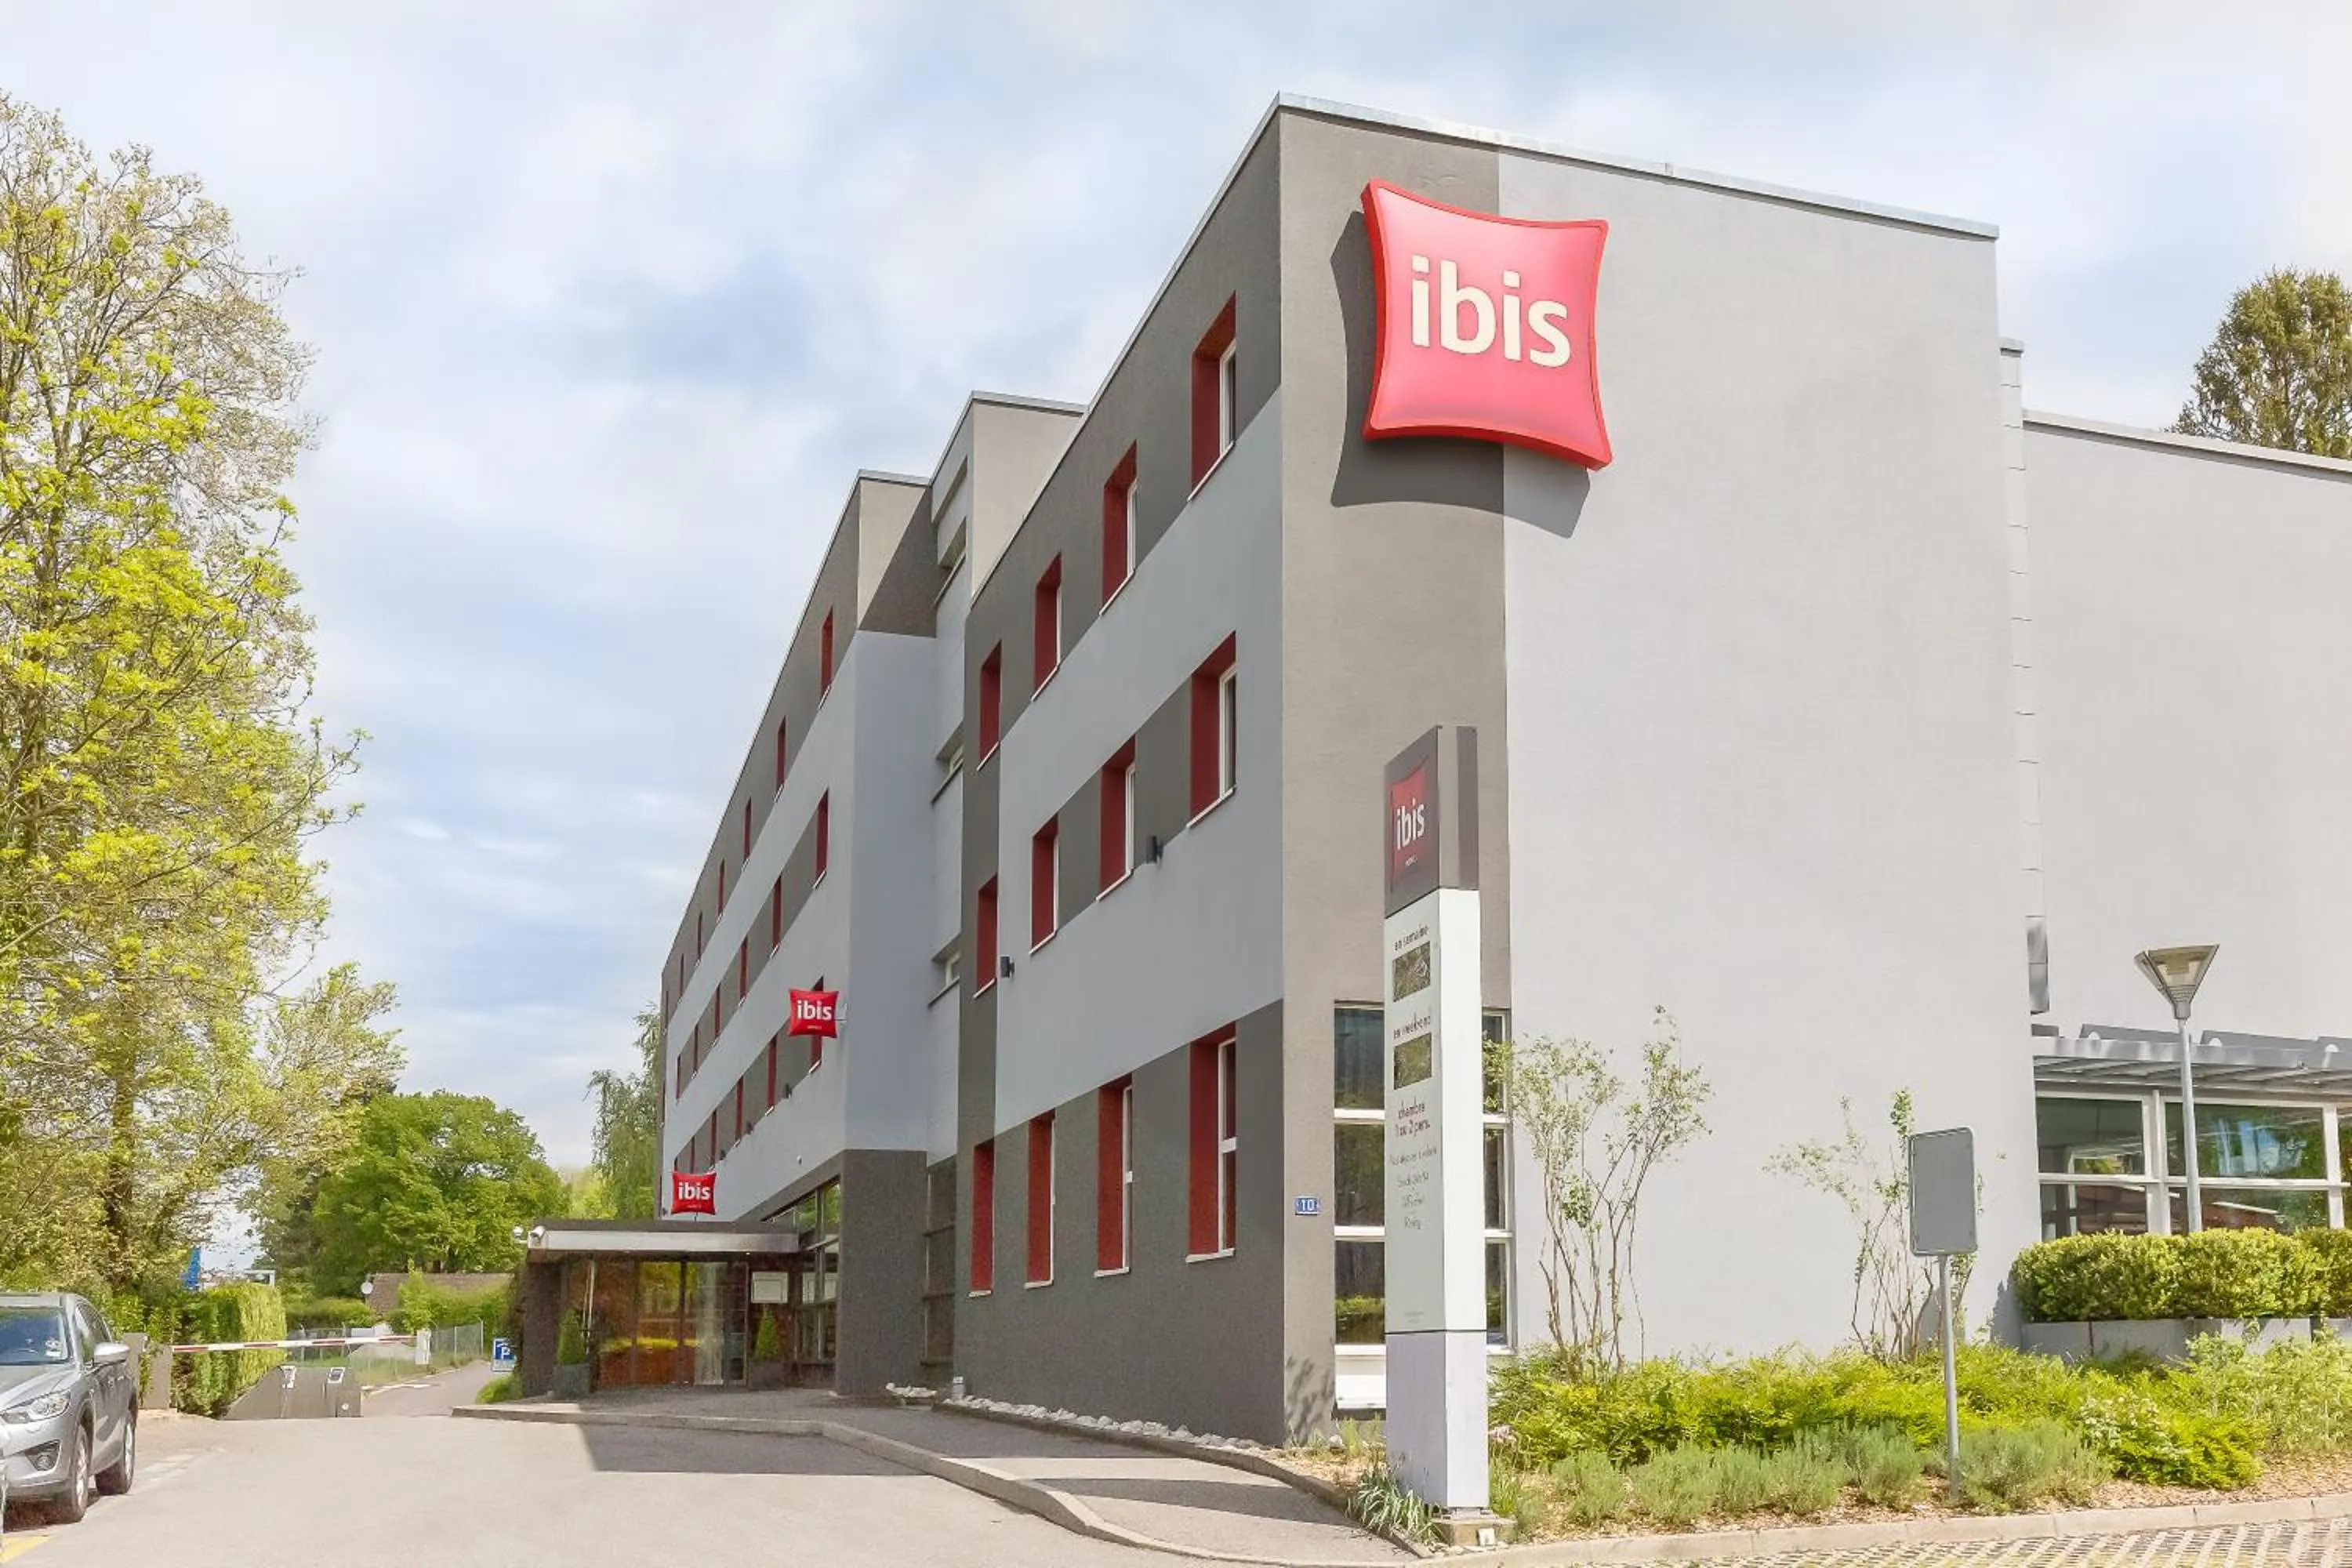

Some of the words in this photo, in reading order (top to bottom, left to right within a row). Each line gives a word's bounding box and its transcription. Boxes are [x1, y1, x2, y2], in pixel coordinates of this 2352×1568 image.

[1411, 254, 1570, 368] ibis
[1397, 797, 1425, 851] ibis
[797, 1000, 832, 1020] ibis
[678, 1181, 710, 1200] ibis
[1301, 1199, 1315, 1211] 10
[501, 1346, 510, 1359] P
